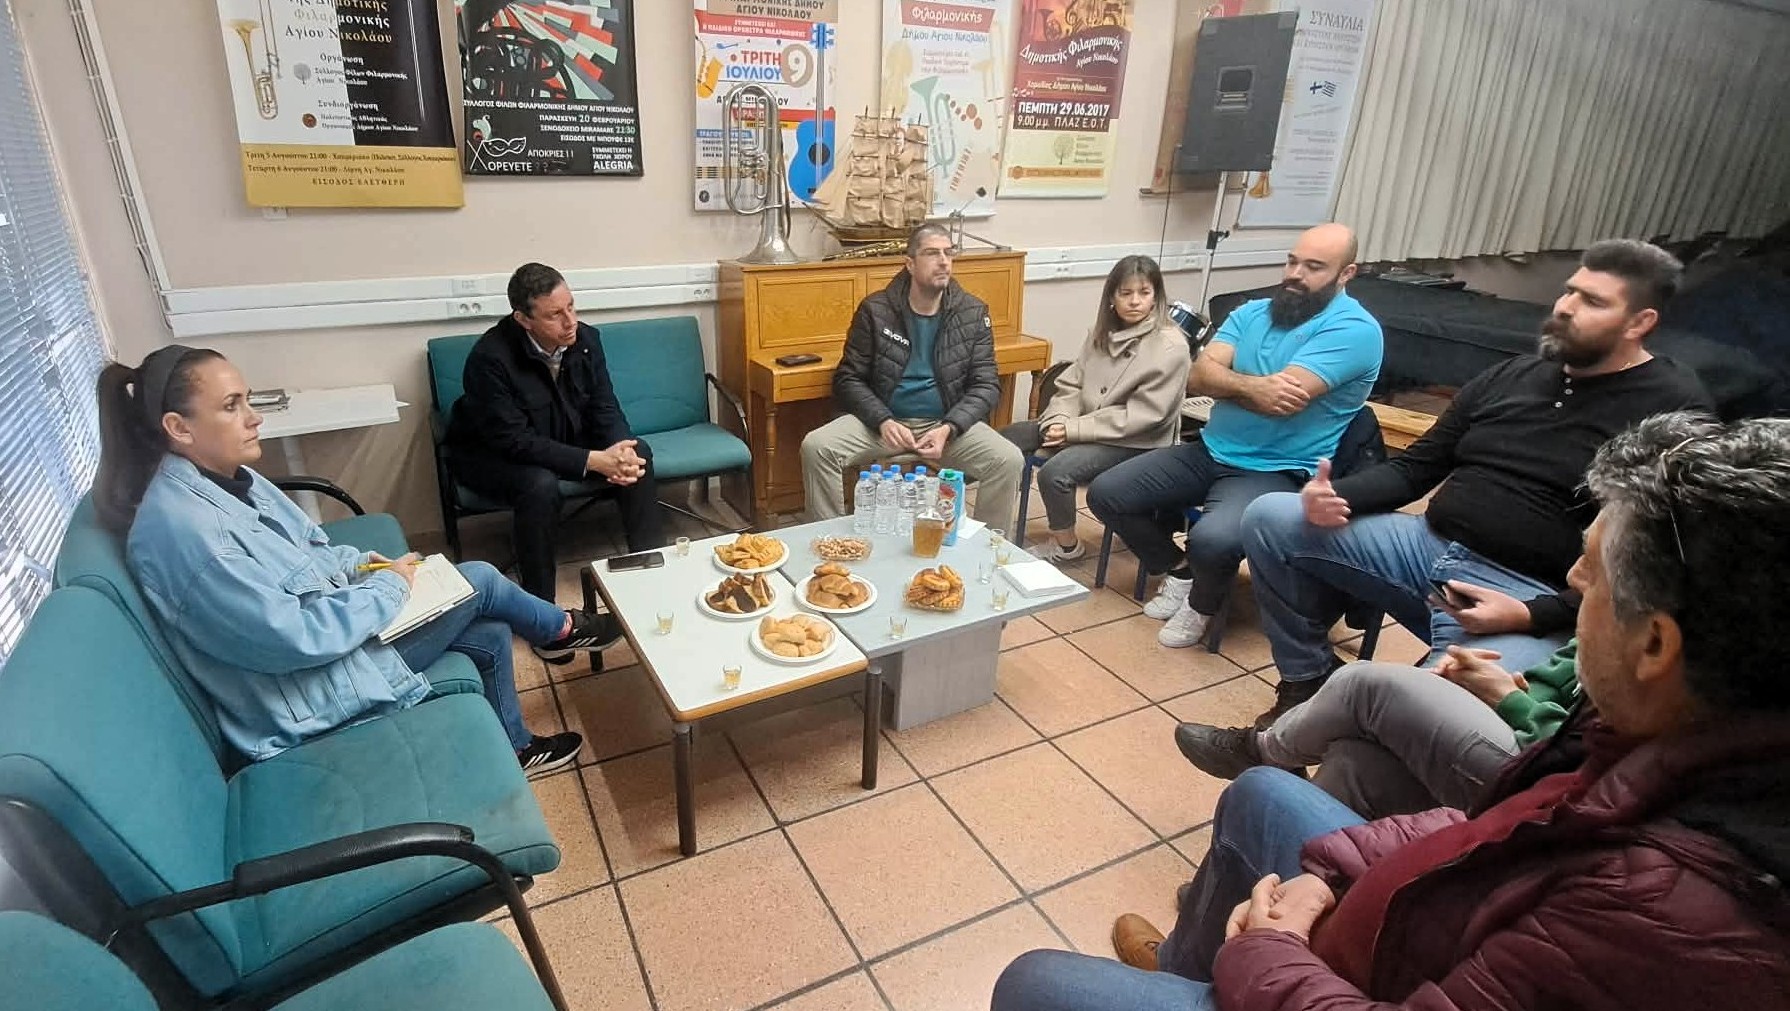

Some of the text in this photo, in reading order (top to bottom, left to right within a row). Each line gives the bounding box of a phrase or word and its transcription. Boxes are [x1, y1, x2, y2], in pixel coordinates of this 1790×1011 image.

[294, 9, 390, 29] Φιλαρμονικής
[736, 5, 812, 19] ΑΓΙΟΥ ΝΙΚΟΛΑΟΥ
[912, 6, 983, 25] Φιλαρμονικής
[1309, 9, 1364, 32] ΣΥΝΑΥΛΙΑ
[285, 25, 392, 43] Αγίου Νικολάου
[741, 50, 782, 65] ΤΡΙΤΗ
[1020, 35, 1123, 65] Δημοτικής Φιλαρμονικής
[726, 65, 782, 80] ΙΟΥΛΙΟΥ
[463, 99, 495, 108] ΣΥΛΛΟΓΟΣ
[495, 100, 517, 109] ΦΙΛΩΝ
[518, 101, 566, 111] ΦΙΛΑΡΜΟΝΙΚΗΣ
[1018, 101, 1110, 117] ΠΕΜΠΤΗ 29.06.2017
[539, 114, 577, 122] ΠΑΡΑΣΚΕΥΗ
[579, 114, 590, 123] 20
[1054, 116, 1080, 128] ΠΛΑΖ
[560, 134, 586, 142] ΕΙΣΟΔΟΣ
[593, 160, 634, 170] ALEGRIA
[312, 178, 405, 186] ΕΙΣΟΔΟΣ ΕΛΕΥΘΕΡΗ
